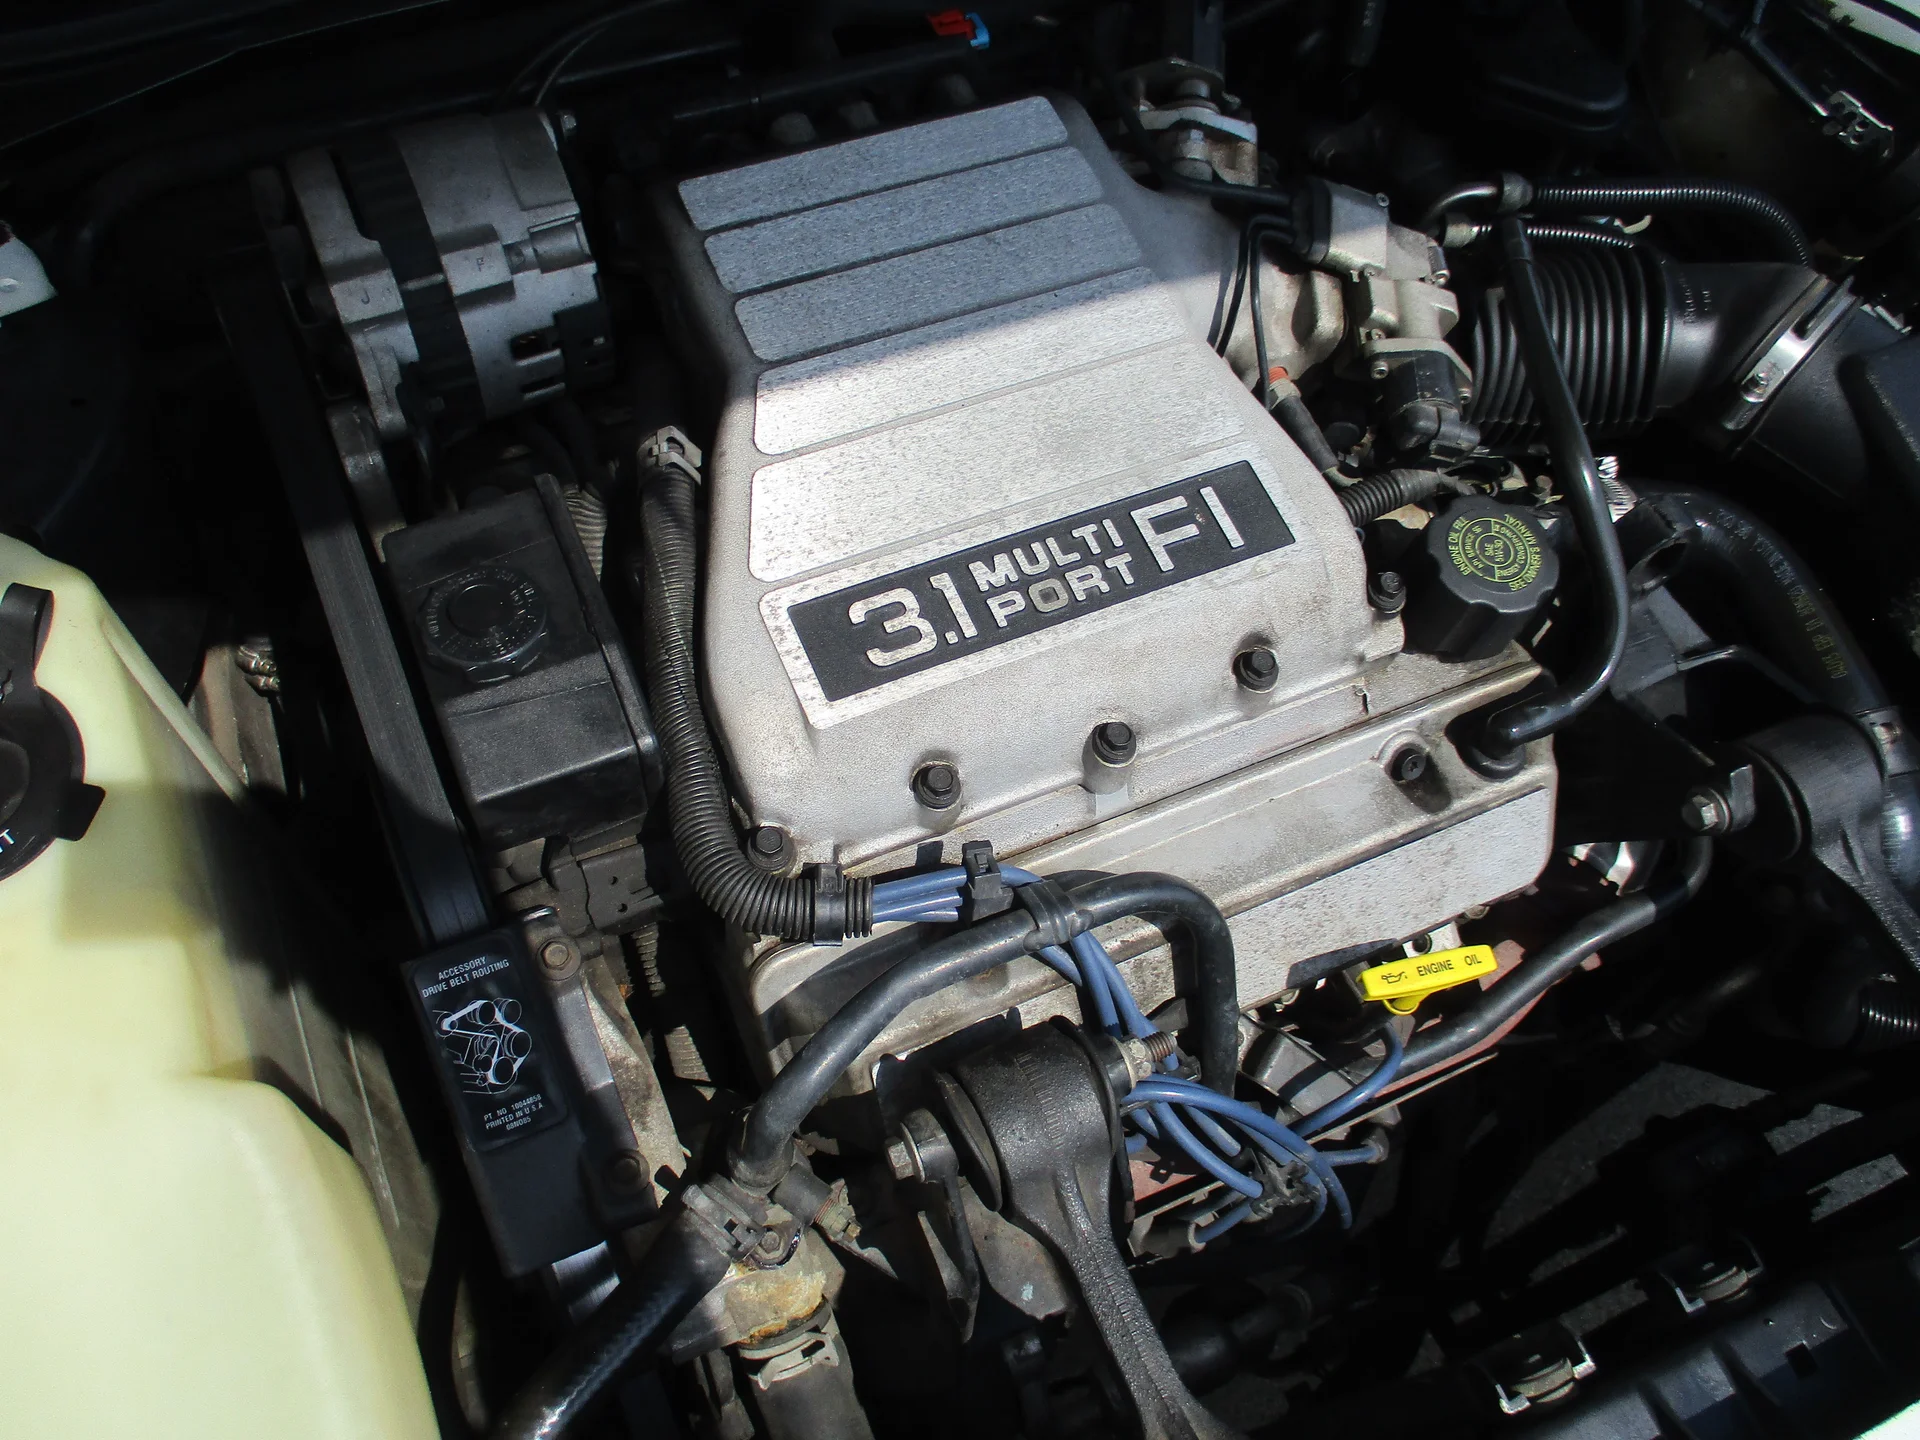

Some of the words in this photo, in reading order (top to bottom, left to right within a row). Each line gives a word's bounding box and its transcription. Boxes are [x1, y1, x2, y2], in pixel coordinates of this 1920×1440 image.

[1129, 485, 1245, 573] FI
[1452, 515, 1470, 530] FILL
[1503, 513, 1537, 545] MANUAL
[1447, 531, 1459, 543] OIL
[1484, 543, 1494, 556] SAE
[966, 517, 1125, 593] MULTI
[1448, 544, 1472, 576] ENGINE
[1471, 557, 1484, 569] API
[1522, 545, 1542, 582] OWNER'S
[984, 553, 1134, 628] PORT
[1508, 580, 1527, 591] SEE
[846, 570, 978, 668] 3.1
[422, 981, 448, 998] DRIVE
[450, 973, 470, 989] BELT
[472, 959, 509, 980] ROUTING
[438, 957, 486, 980] ACCESSORY
[1416, 959, 1454, 977] ENGINE
[1464, 953, 1482, 966] OIL
[486, 1114, 514, 1130] PRINTED
[515, 1110, 524, 1119] IN
